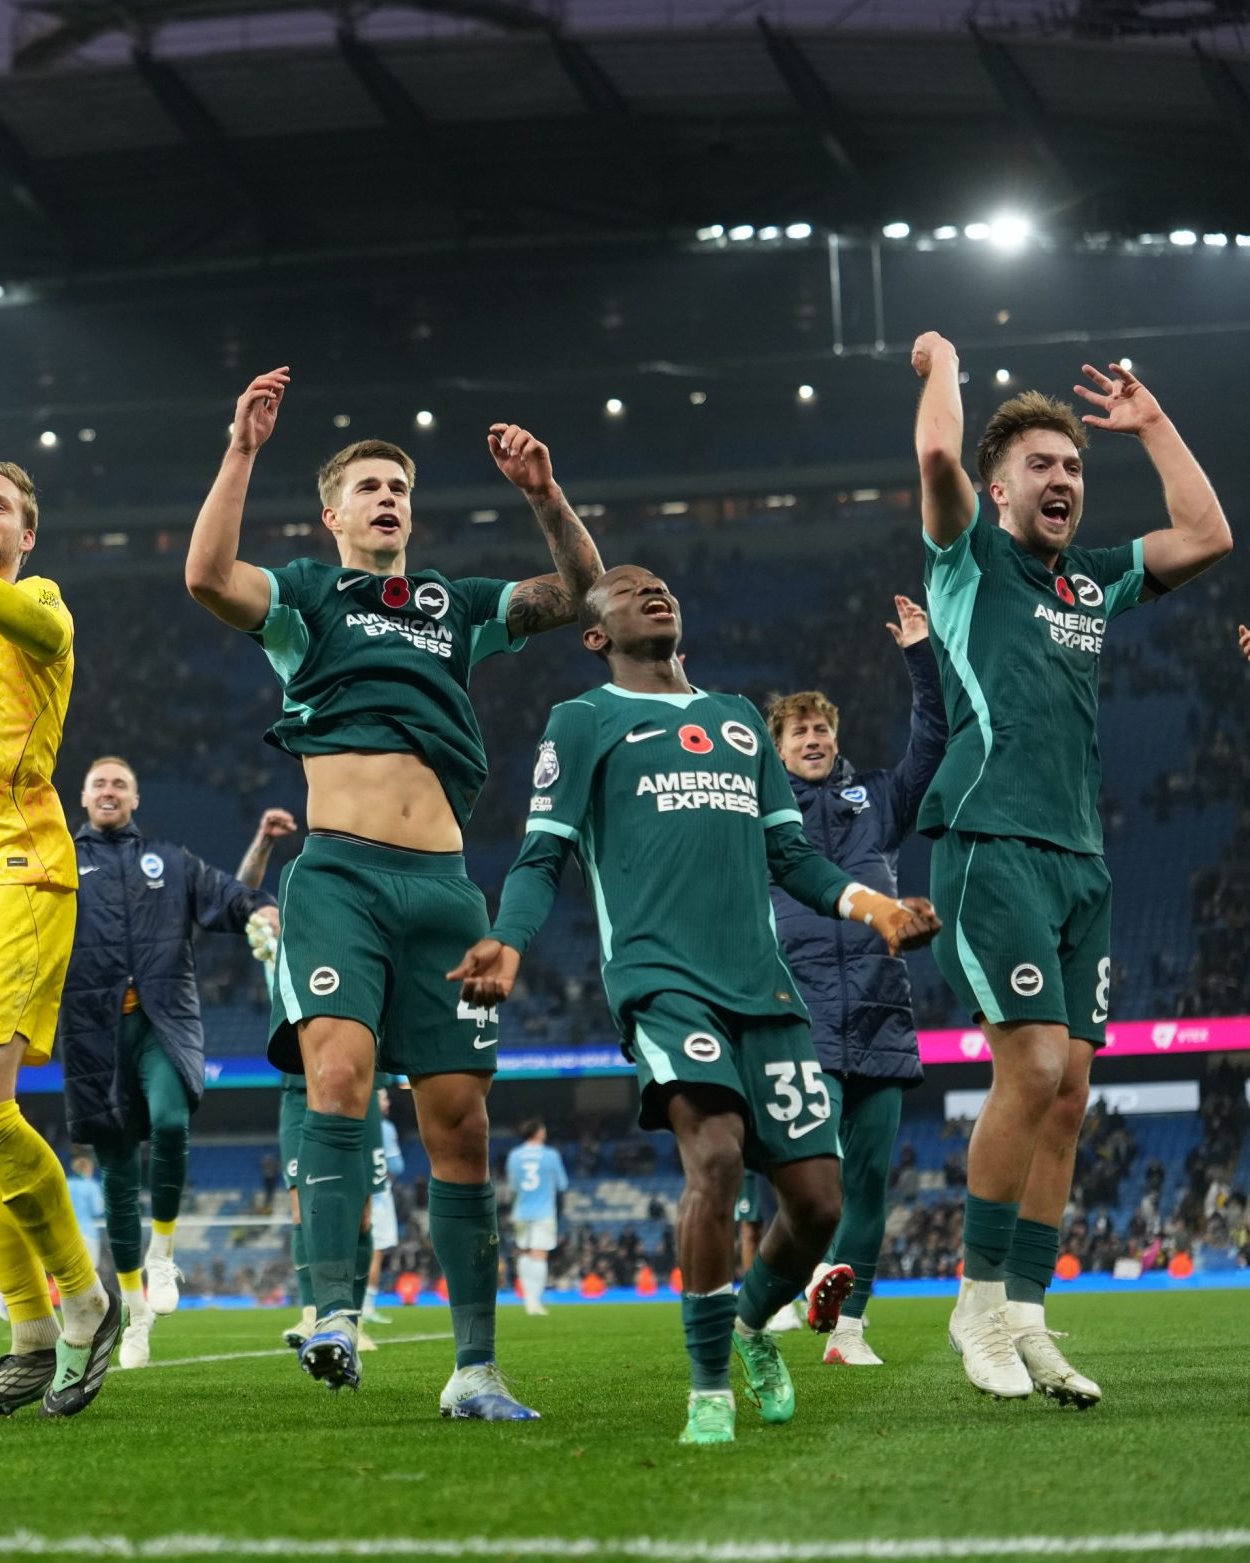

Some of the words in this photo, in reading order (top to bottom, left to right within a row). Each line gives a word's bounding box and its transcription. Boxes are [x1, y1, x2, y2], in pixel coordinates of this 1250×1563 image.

[1034, 604, 1106, 635] AMERIC
[636, 770, 757, 798] AMERICAN
[656, 791, 759, 818] EXPRESS
[764, 1061, 831, 1122] 35
[520, 1161, 541, 1192] 3
